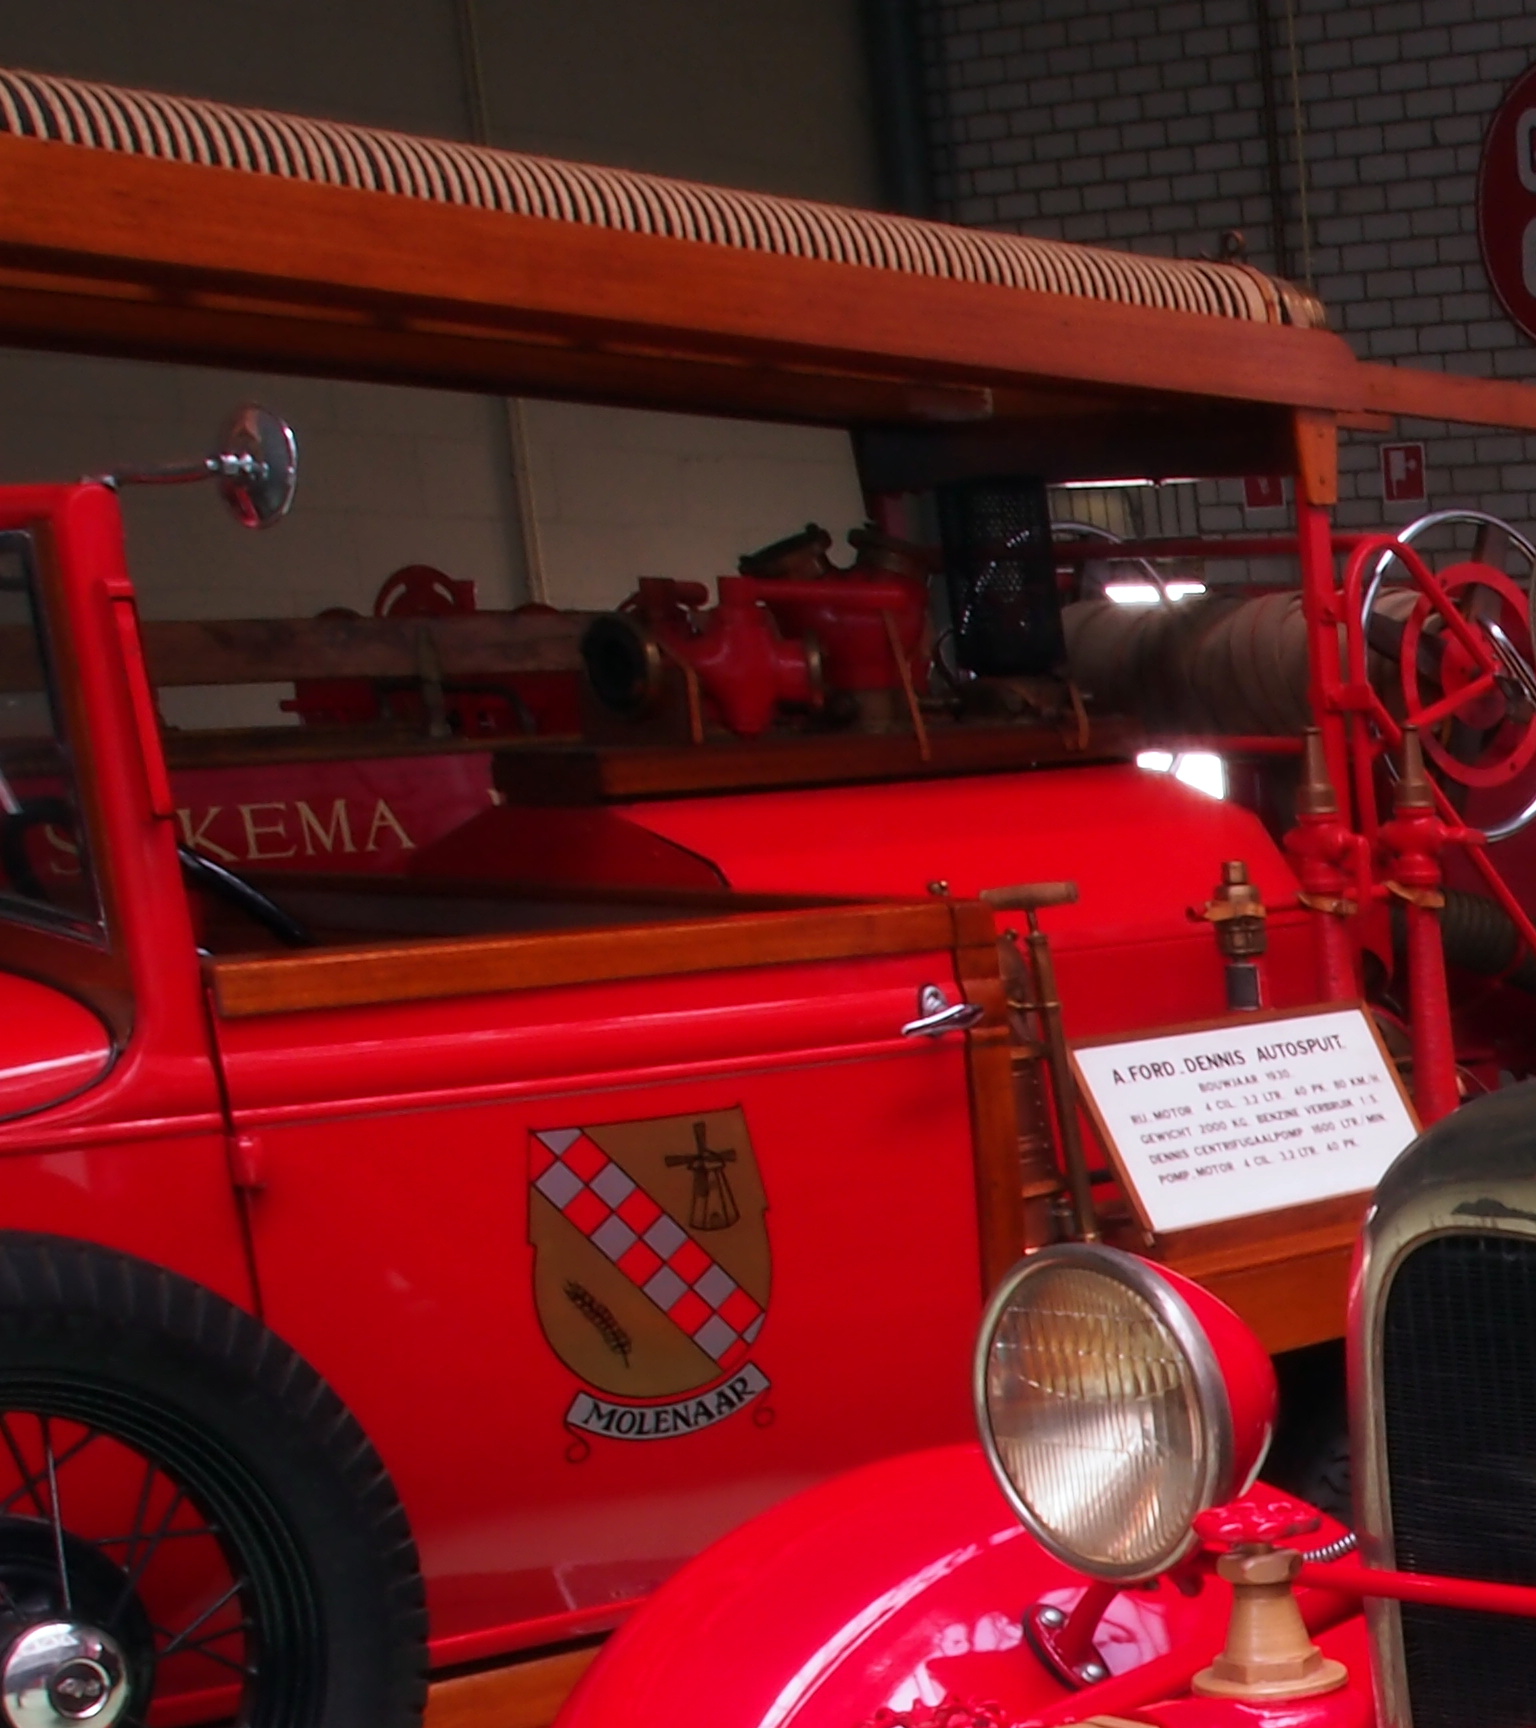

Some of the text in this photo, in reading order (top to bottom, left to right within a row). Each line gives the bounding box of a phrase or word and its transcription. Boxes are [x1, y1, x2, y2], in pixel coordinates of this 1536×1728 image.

[1198, 1076, 1259, 1092] BOUWJAAR
[1140, 1127, 1193, 1145] GEWICHT
[1196, 1120, 1229, 1134] 2000
[1255, 1108, 1300, 1124] BENZINE
[1304, 1099, 1353, 1115] VERBRUIK
[1147, 1148, 1191, 1165] DENNIS
[582, 1375, 756, 1436] MOLENAAR
